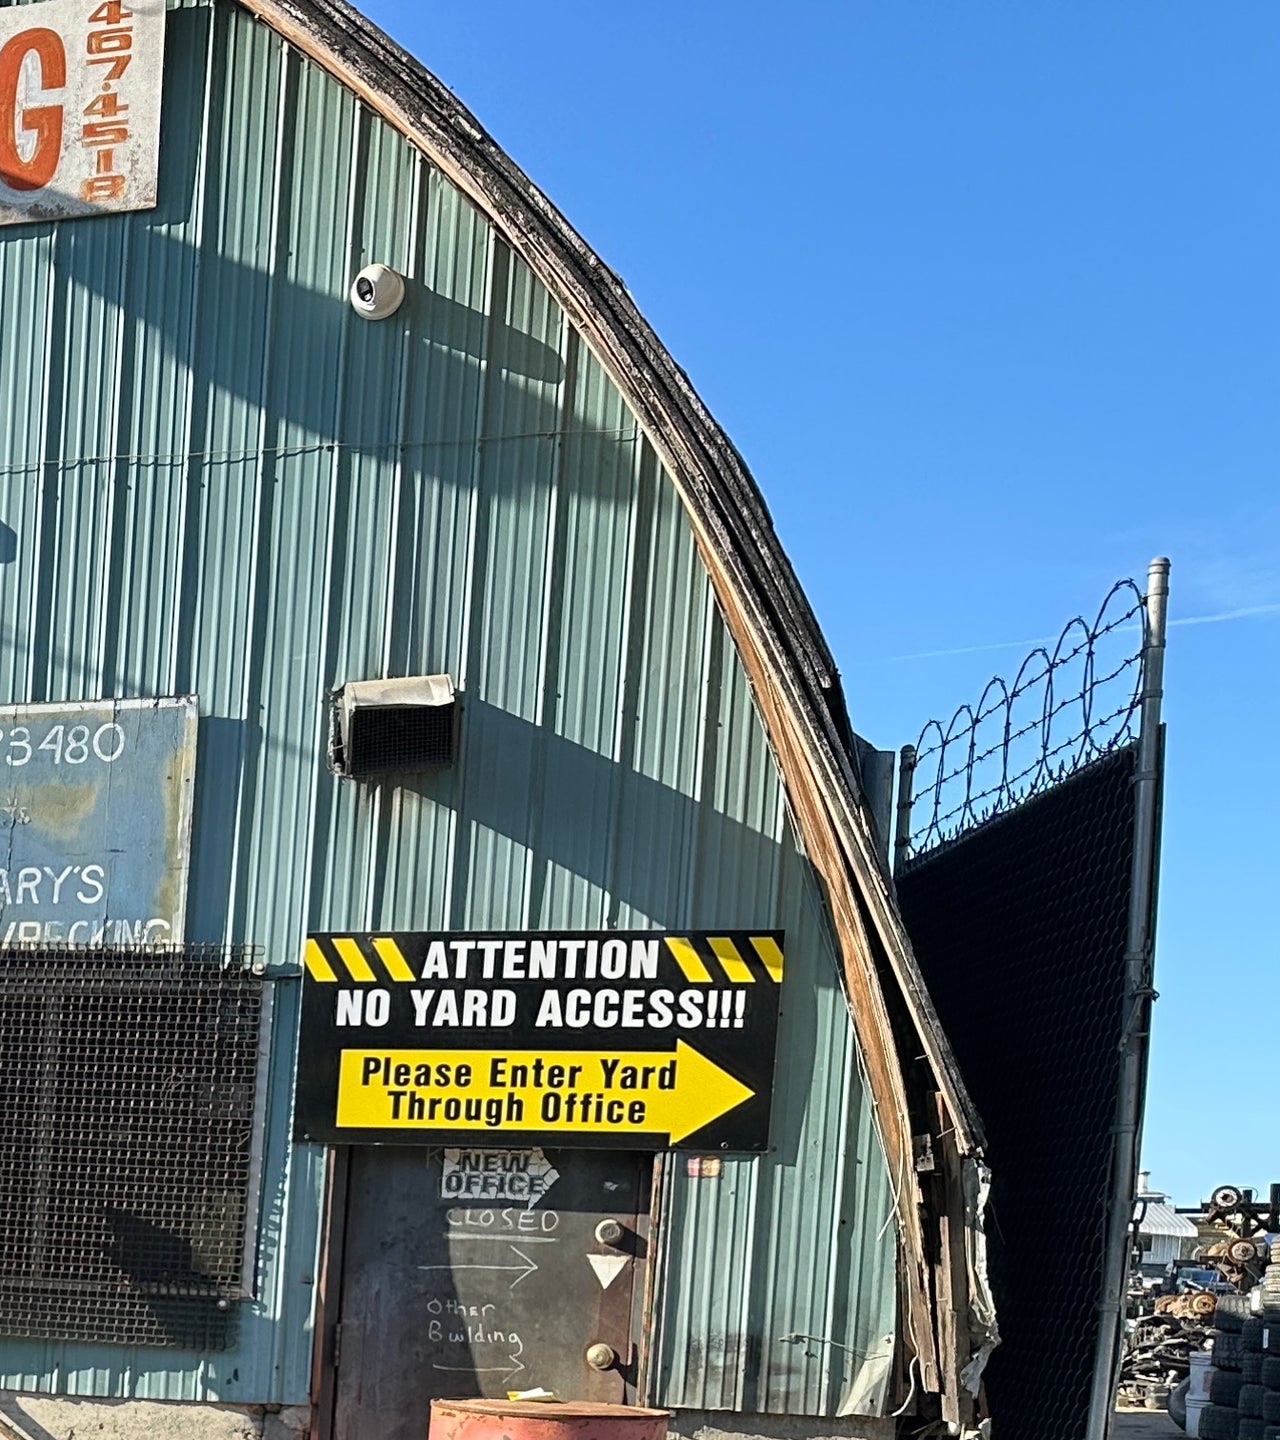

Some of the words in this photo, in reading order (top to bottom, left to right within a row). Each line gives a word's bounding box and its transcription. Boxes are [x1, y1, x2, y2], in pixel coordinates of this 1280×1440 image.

[421, 939, 658, 979] ATTENTION
[336, 989, 391, 1027] NO
[412, 990, 517, 1027] YARD
[535, 989, 746, 1028] ACCESS!!!
[362, 1056, 472, 1088] Please
[490, 1058, 582, 1089] Enter
[601, 1058, 677, 1091] Yard
[388, 1090, 524, 1127] Through
[541, 1092, 646, 1125] Office
[460, 1151, 530, 1173] NEW
[445, 1172, 545, 1195] OFFICE
[447, 1207, 560, 1232] CLOSED
[428, 1320, 524, 1357] Building
